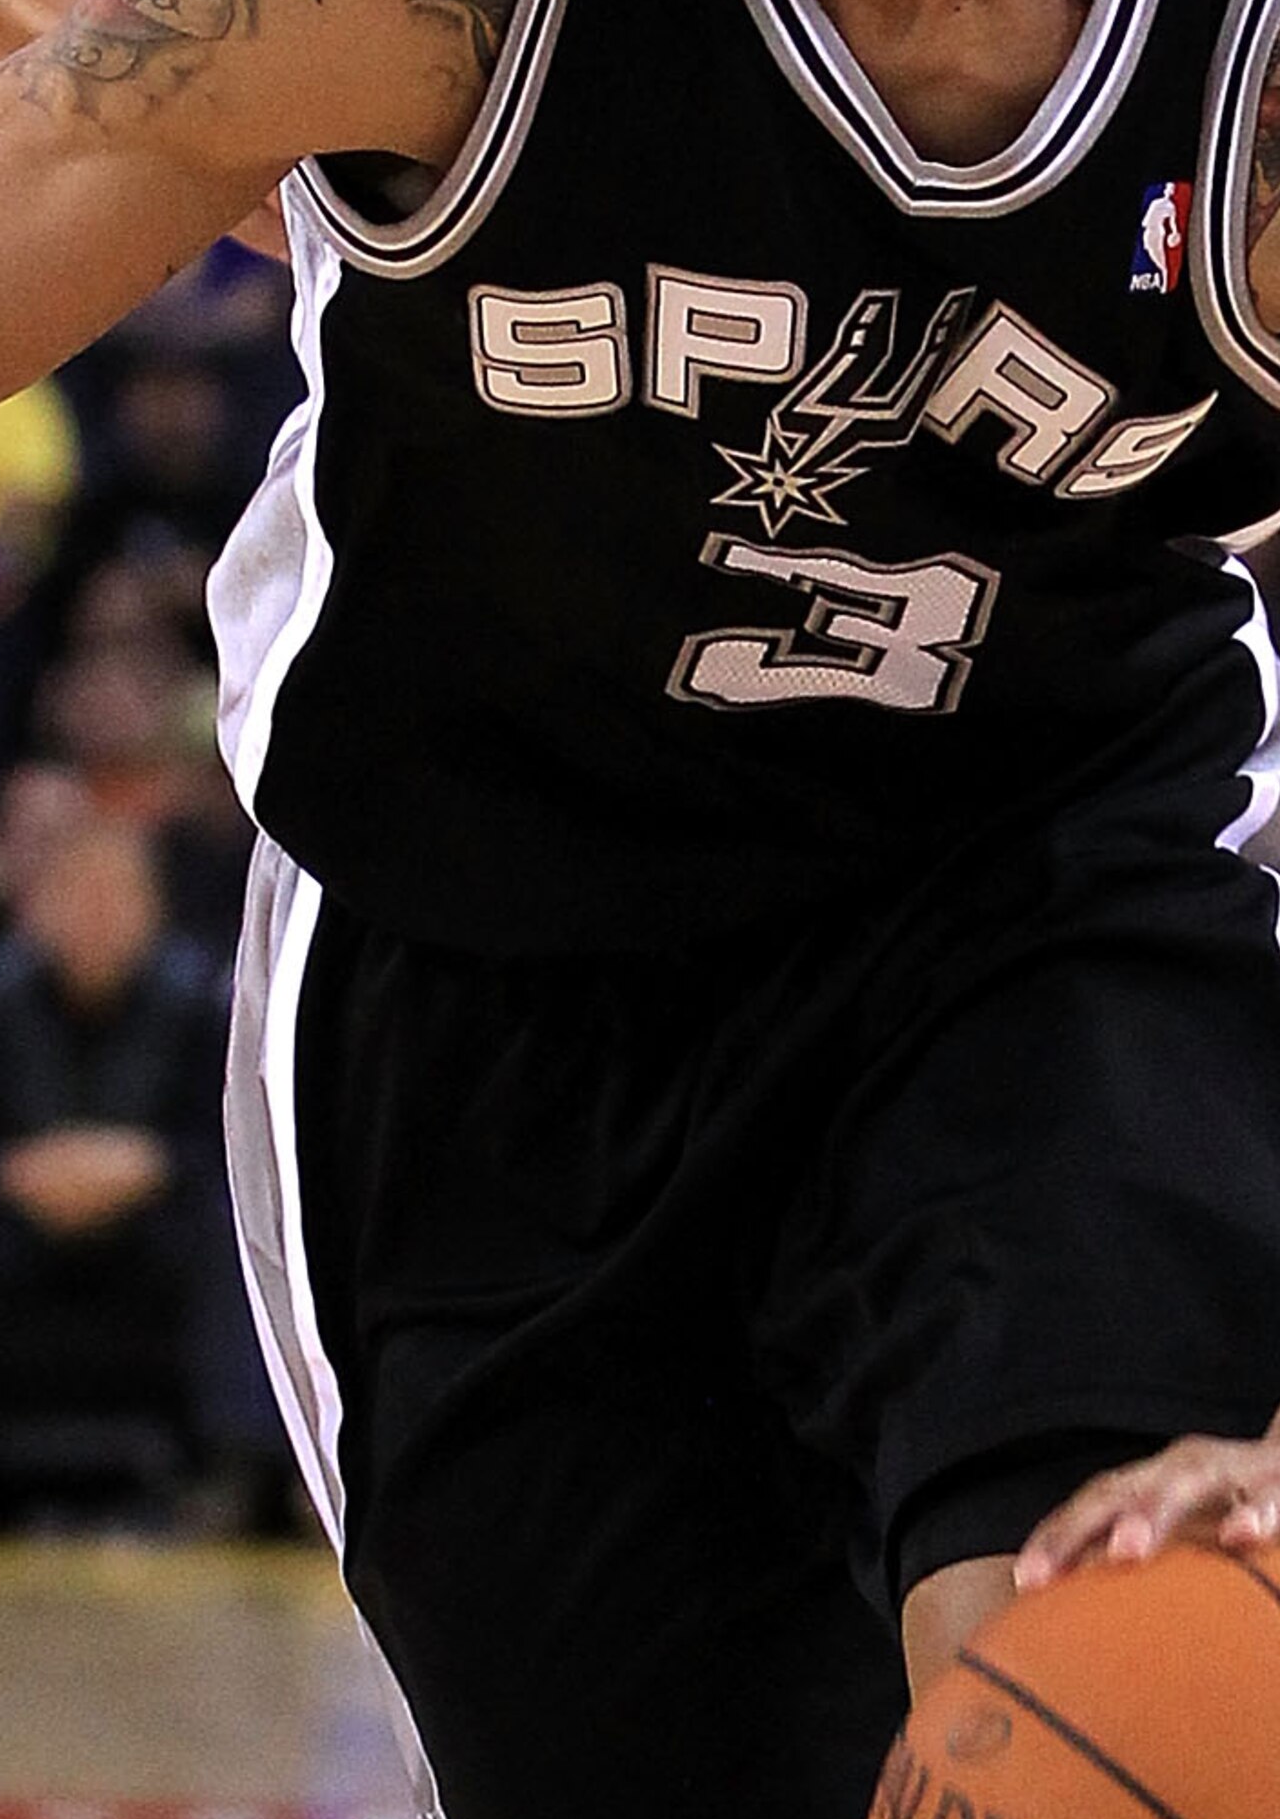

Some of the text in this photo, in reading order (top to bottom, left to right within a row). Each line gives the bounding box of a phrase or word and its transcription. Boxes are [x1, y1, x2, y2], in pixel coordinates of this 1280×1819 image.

[1128, 272, 1161, 292] NBA
[467, 263, 1219, 502] SPURS
[664, 532, 1001, 714] 3
